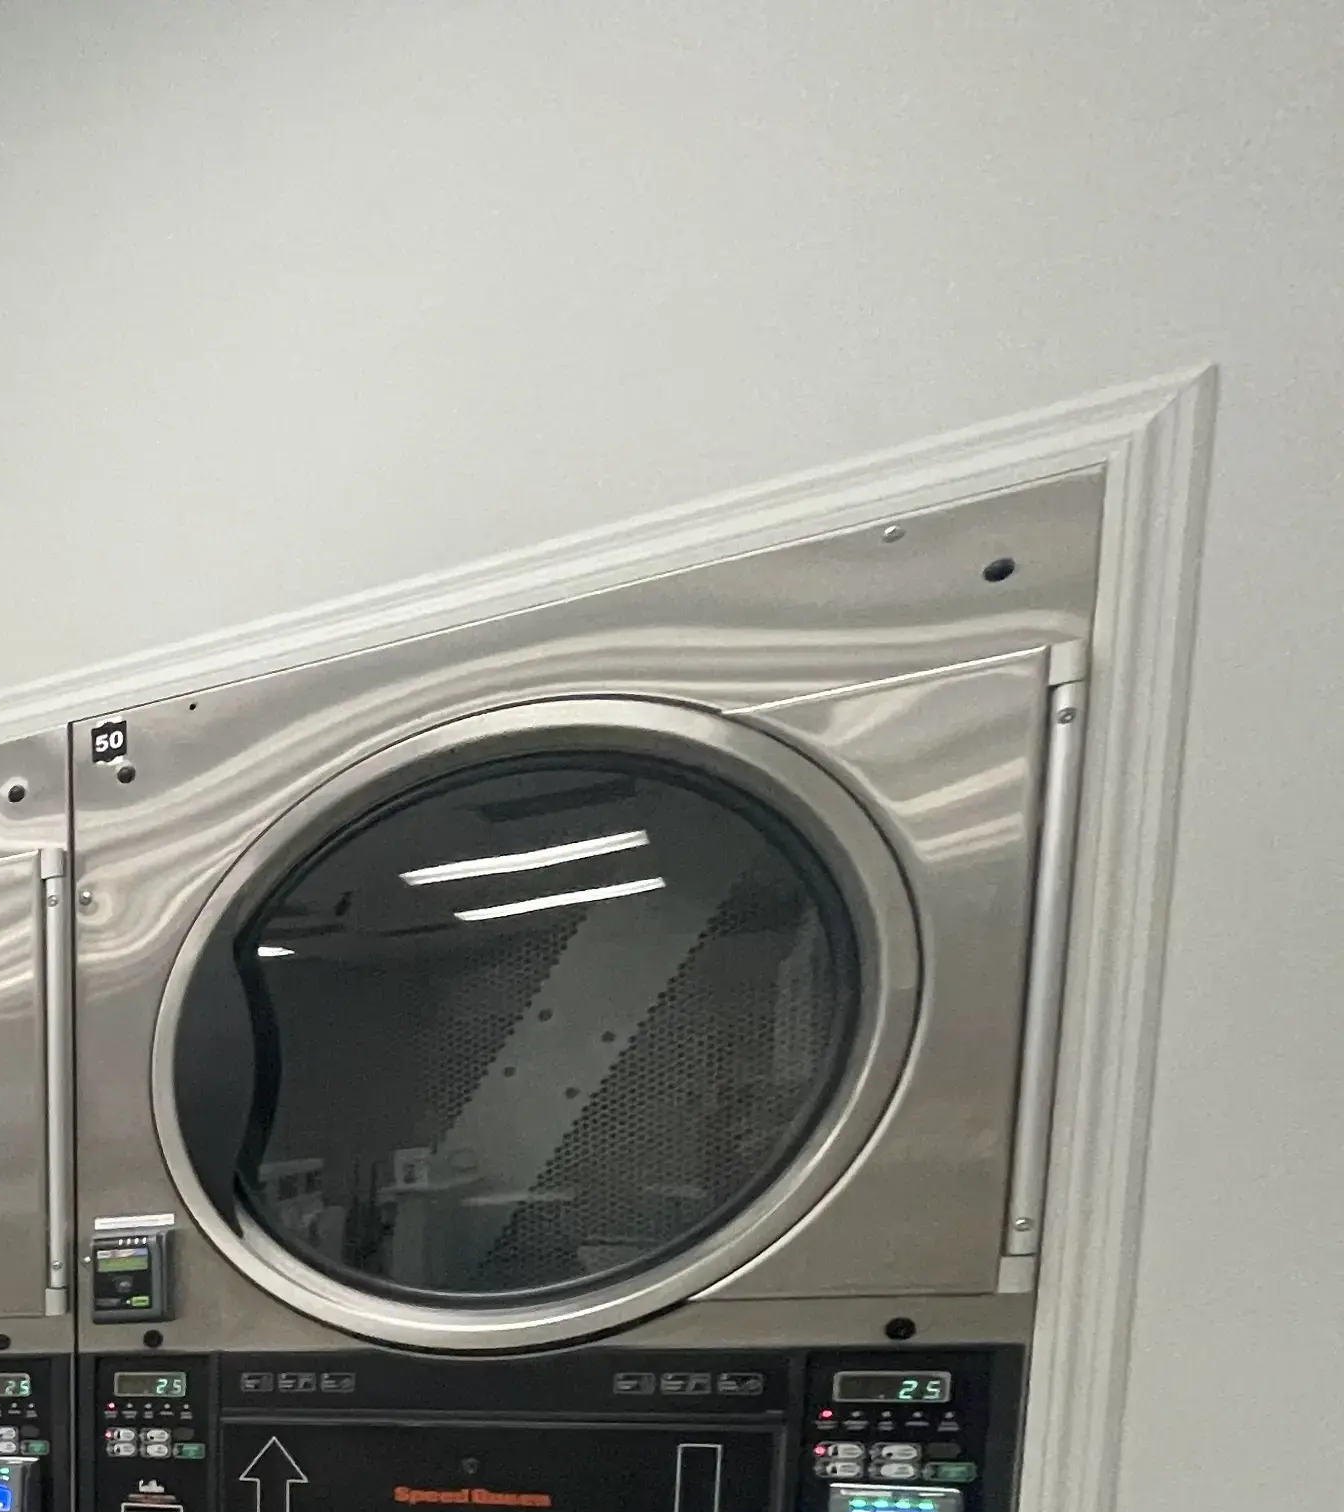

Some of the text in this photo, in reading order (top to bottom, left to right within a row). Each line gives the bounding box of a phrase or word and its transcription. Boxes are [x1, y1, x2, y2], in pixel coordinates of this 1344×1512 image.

[95, 730, 124, 752] 50
[156, 1378, 182, 1395] 25
[898, 1379, 941, 1400] 25
[393, 1486, 469, 1506] Speed
